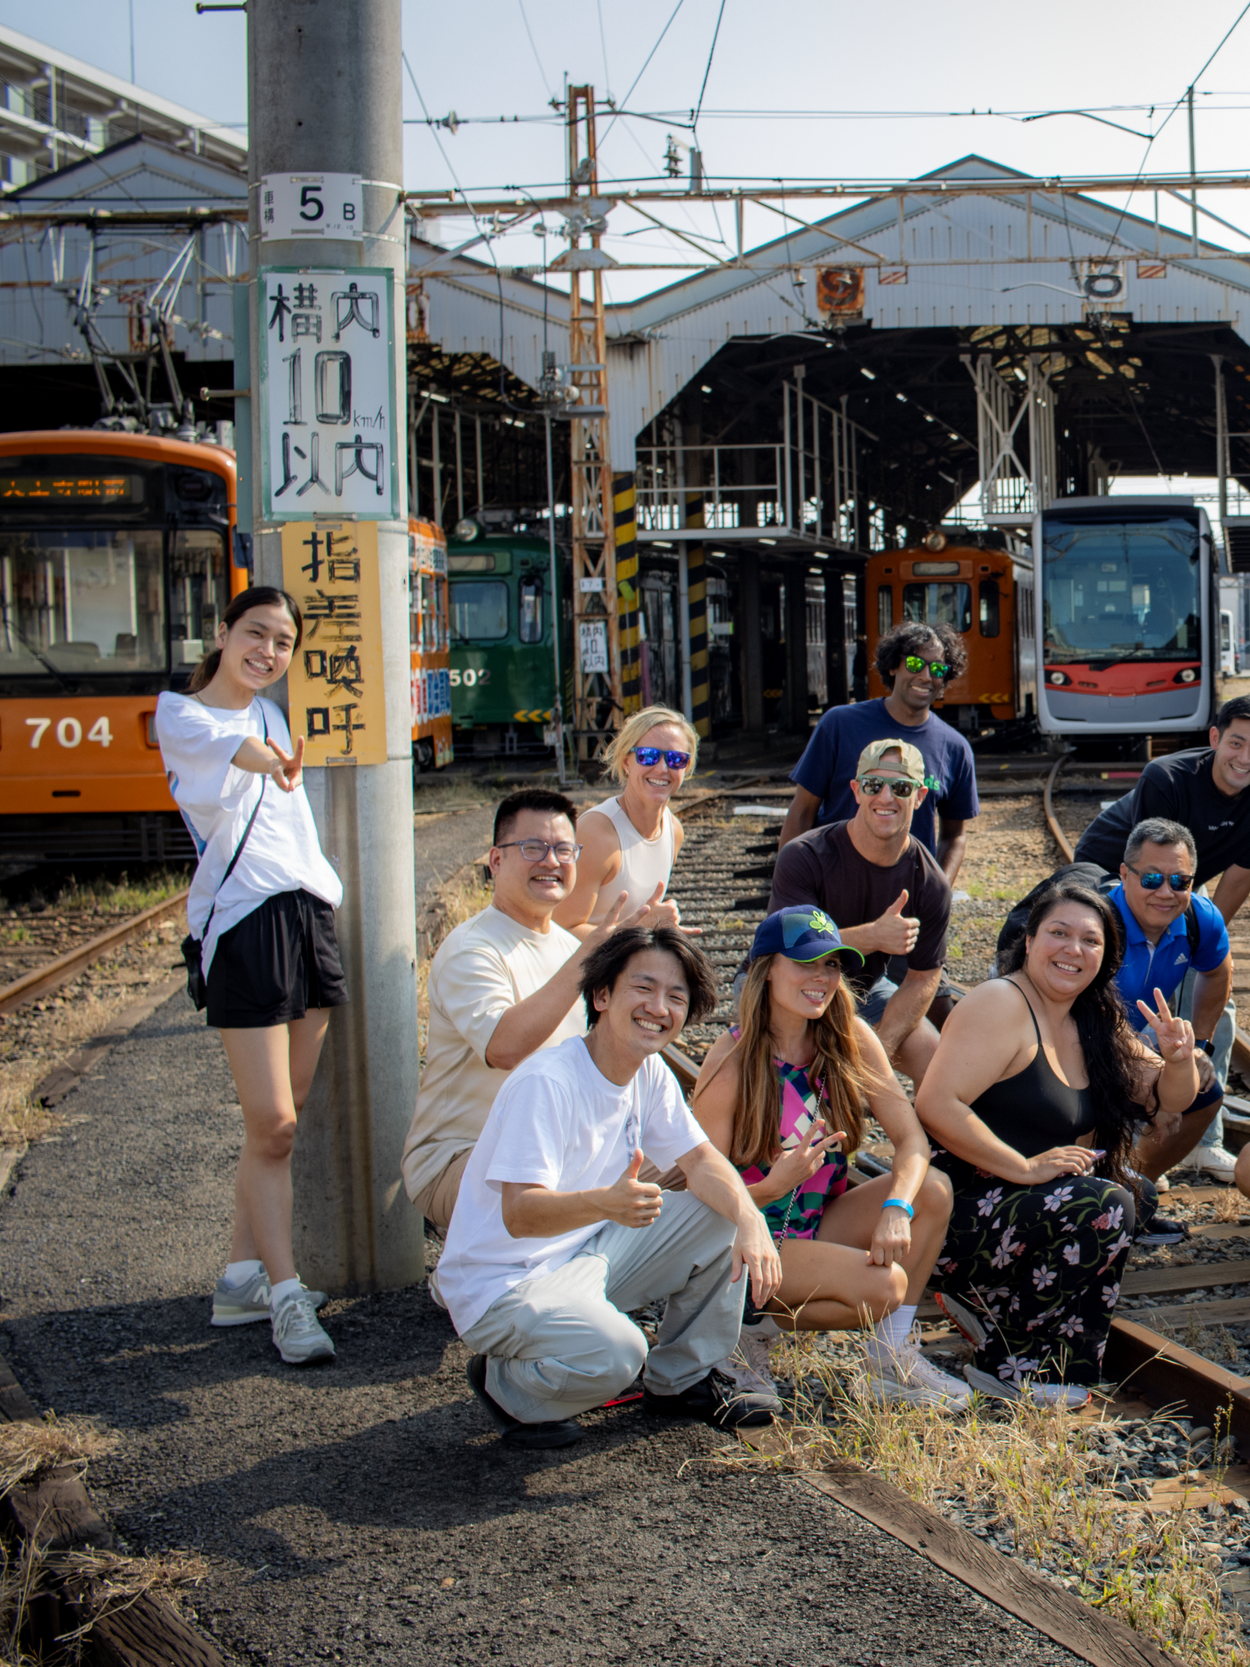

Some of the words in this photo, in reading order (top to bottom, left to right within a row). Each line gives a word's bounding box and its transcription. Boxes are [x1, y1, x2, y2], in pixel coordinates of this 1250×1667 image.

[300, 186, 324, 221] 5
[343, 203, 355, 220] B
[821, 267, 860, 306] 9
[269, 283, 380, 343] 構内
[283, 347, 352, 425] 10
[275, 432, 384, 497] 以内
[301, 531, 365, 755] 指差喚呼
[449, 668, 491, 687] 502
[25, 716, 113, 748] 704
